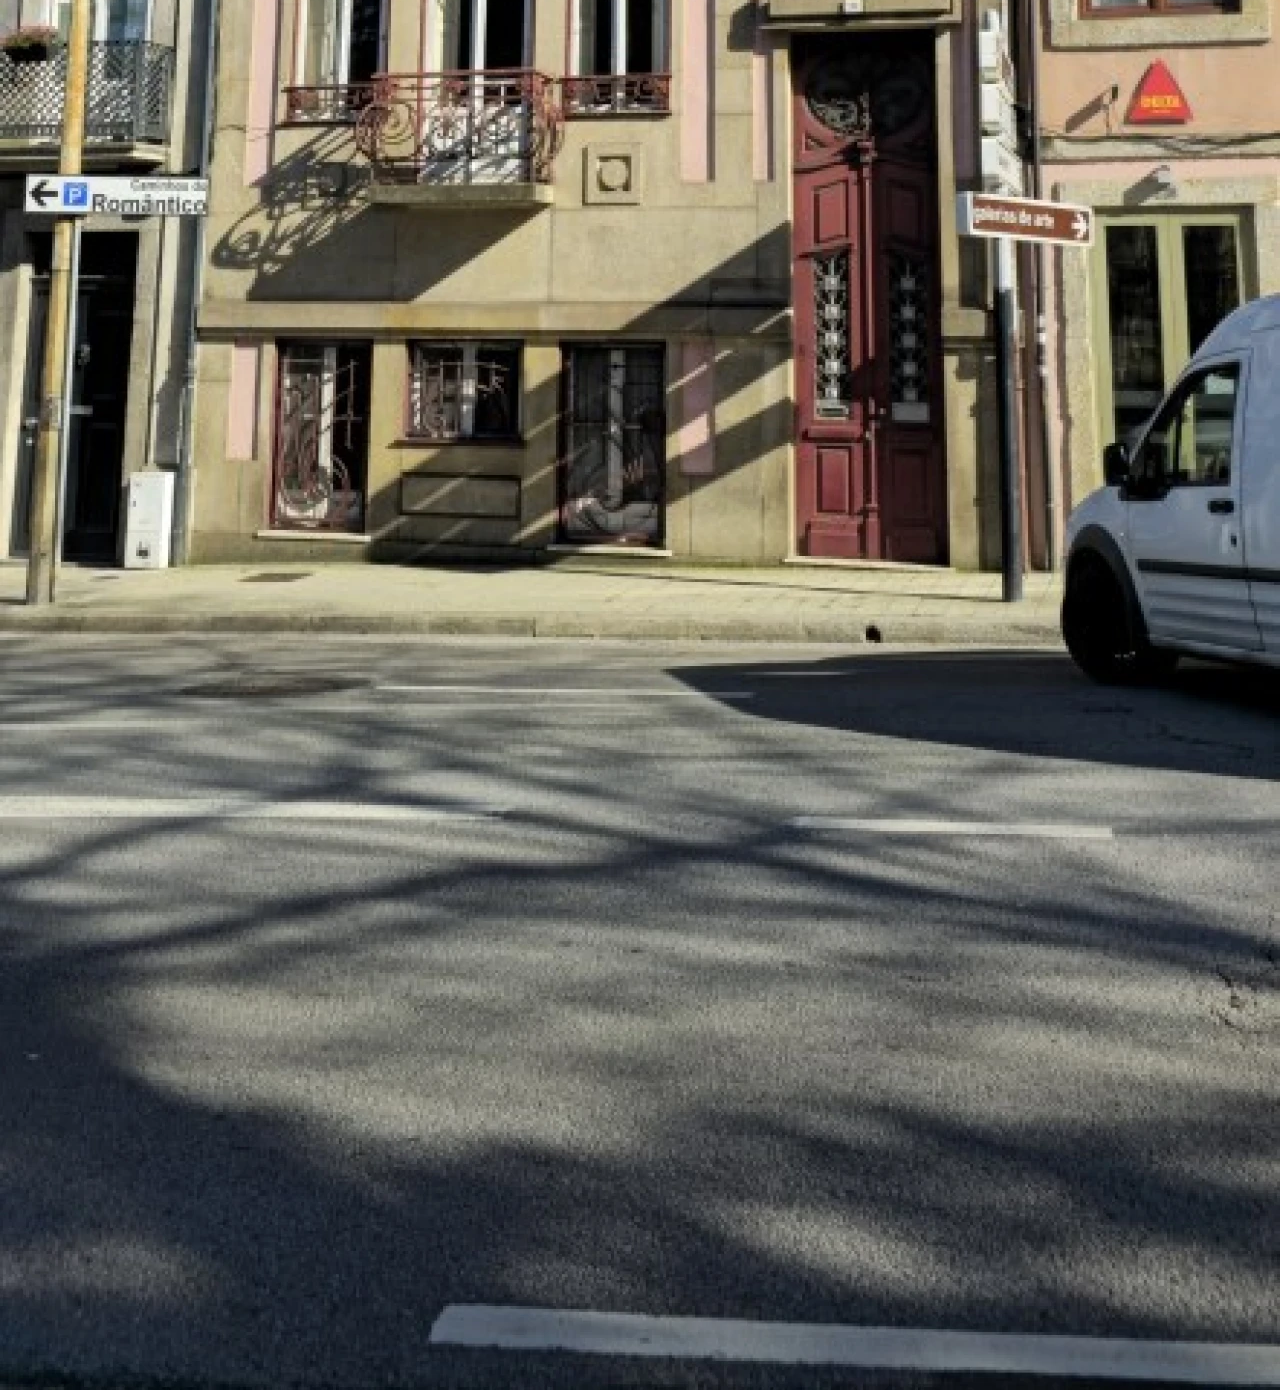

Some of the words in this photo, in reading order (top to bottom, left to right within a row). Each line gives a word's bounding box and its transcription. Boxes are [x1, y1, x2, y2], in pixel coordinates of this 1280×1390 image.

[92, 192, 208, 214] Romântico
[1018, 208, 1032, 227] de
[1033, 211, 1055, 228] arte
